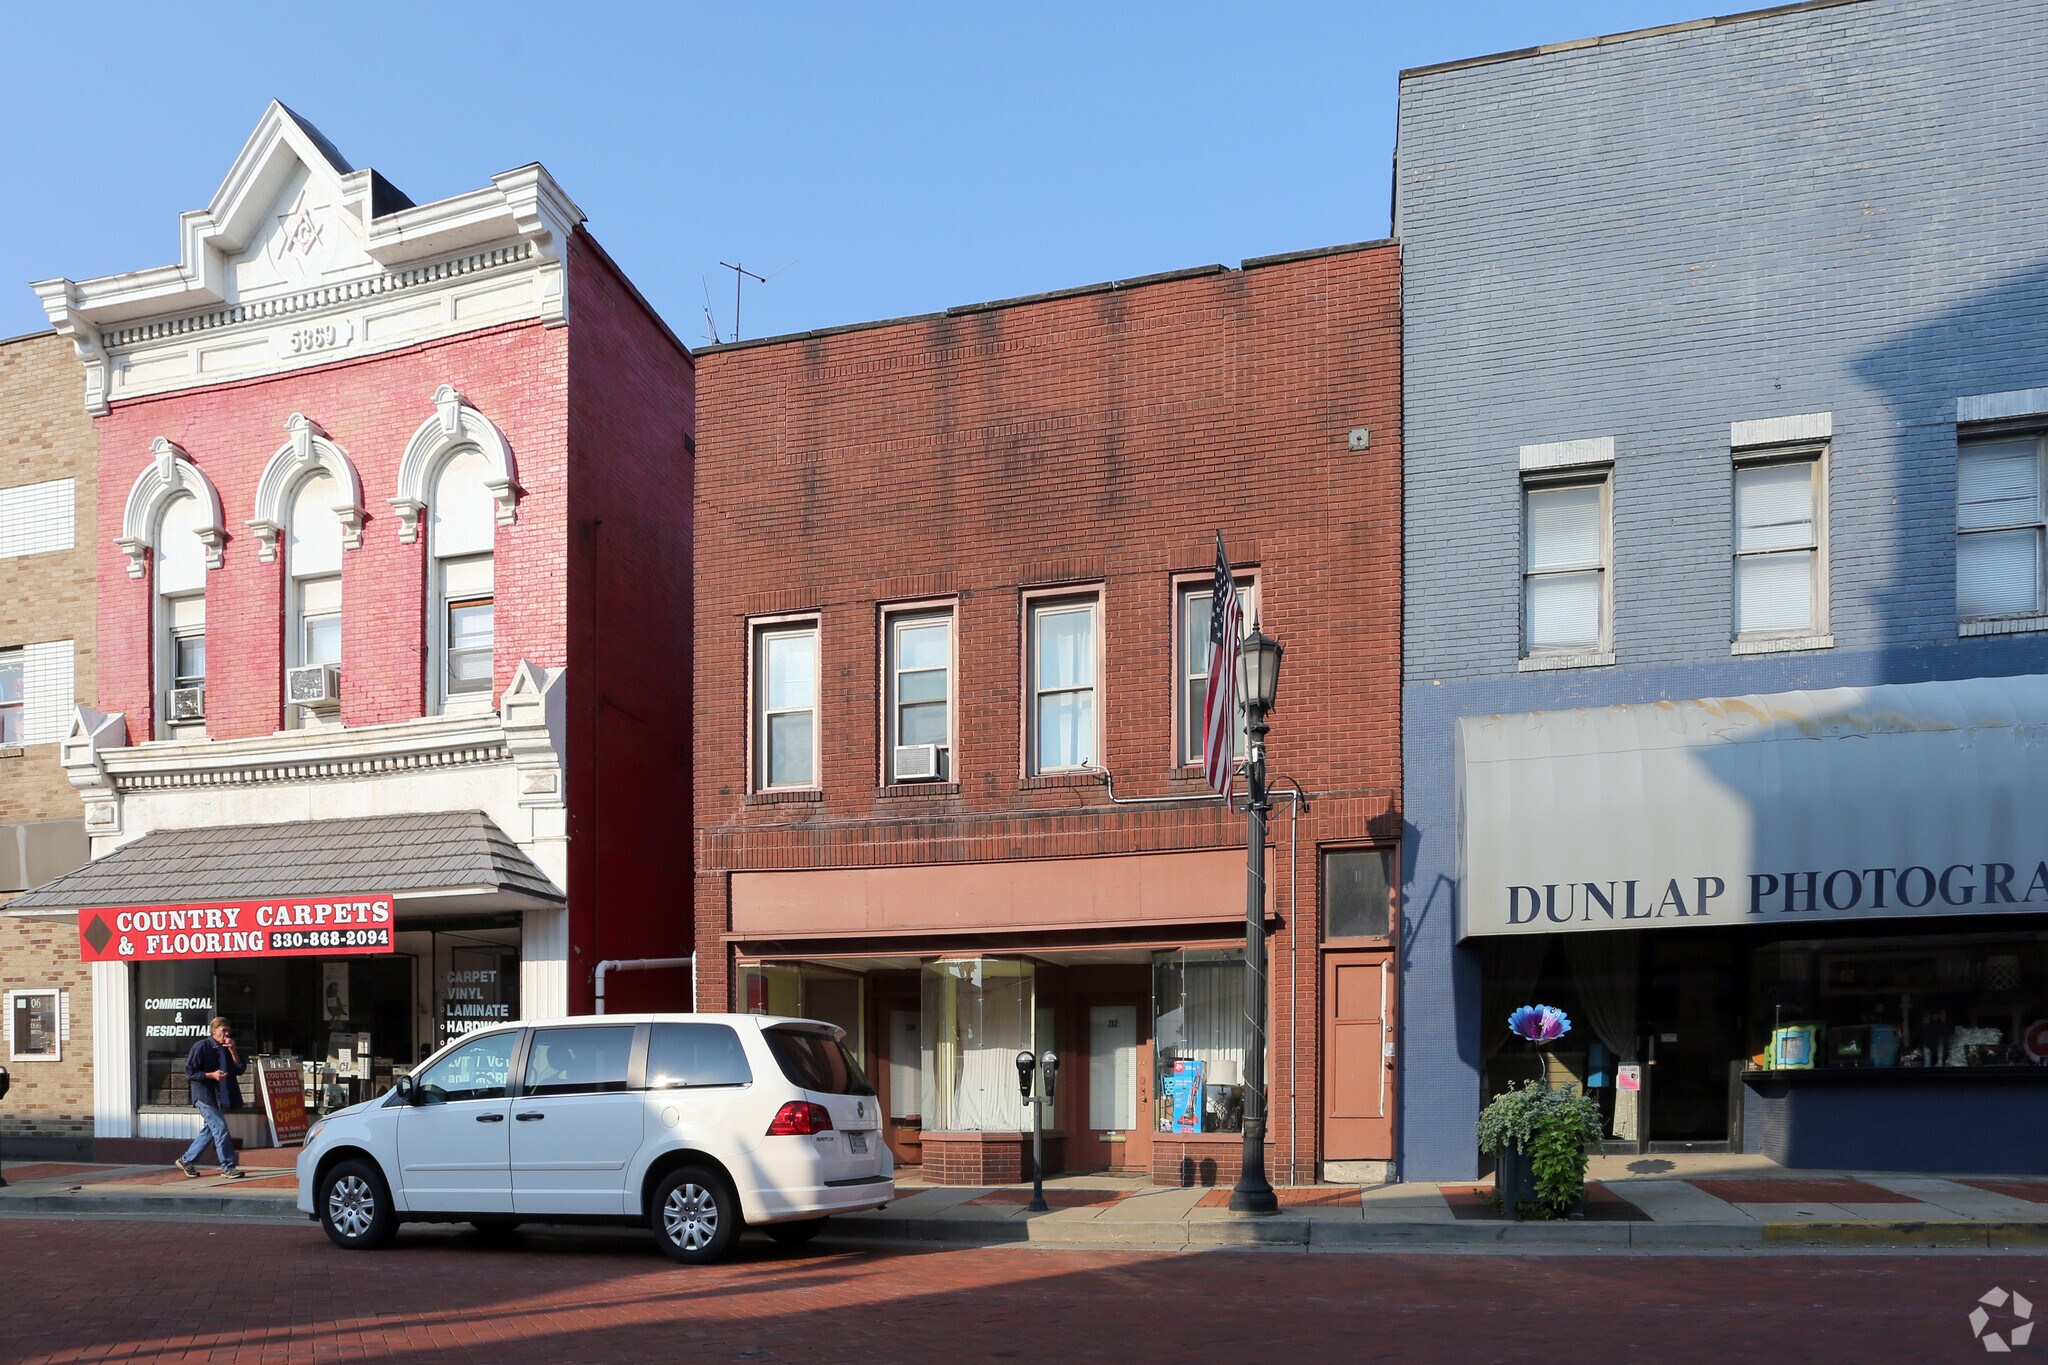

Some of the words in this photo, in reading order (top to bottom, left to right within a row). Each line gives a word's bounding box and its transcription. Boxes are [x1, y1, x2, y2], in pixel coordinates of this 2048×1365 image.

[290, 325, 336, 352] 5869
[1506, 876, 1726, 925] DUNLAP
[1746, 861, 2048, 914] PHOTOGRA
[116, 908, 240, 932] COUNTRY
[256, 902, 389, 926] CARPETS
[118, 937, 134, 956] &
[146, 931, 264, 954] FLOORING
[272, 930, 388, 947] 330-868-2094
[447, 971, 497, 983] CARPET
[447, 987, 484, 1000] VINYL
[145, 998, 213, 1010] COMMERCIAL
[446, 1004, 509, 1017] LAMINATE
[175, 1012, 183, 1023] &
[146, 1026, 212, 1037] RESIDENTIAL
[446, 1020, 507, 1033] HARDW
[265, 1071, 297, 1079] COUNTRY
[448, 1072, 470, 1084] and
[275, 1096, 297, 1109] Now
[276, 1108, 303, 1122] Open
